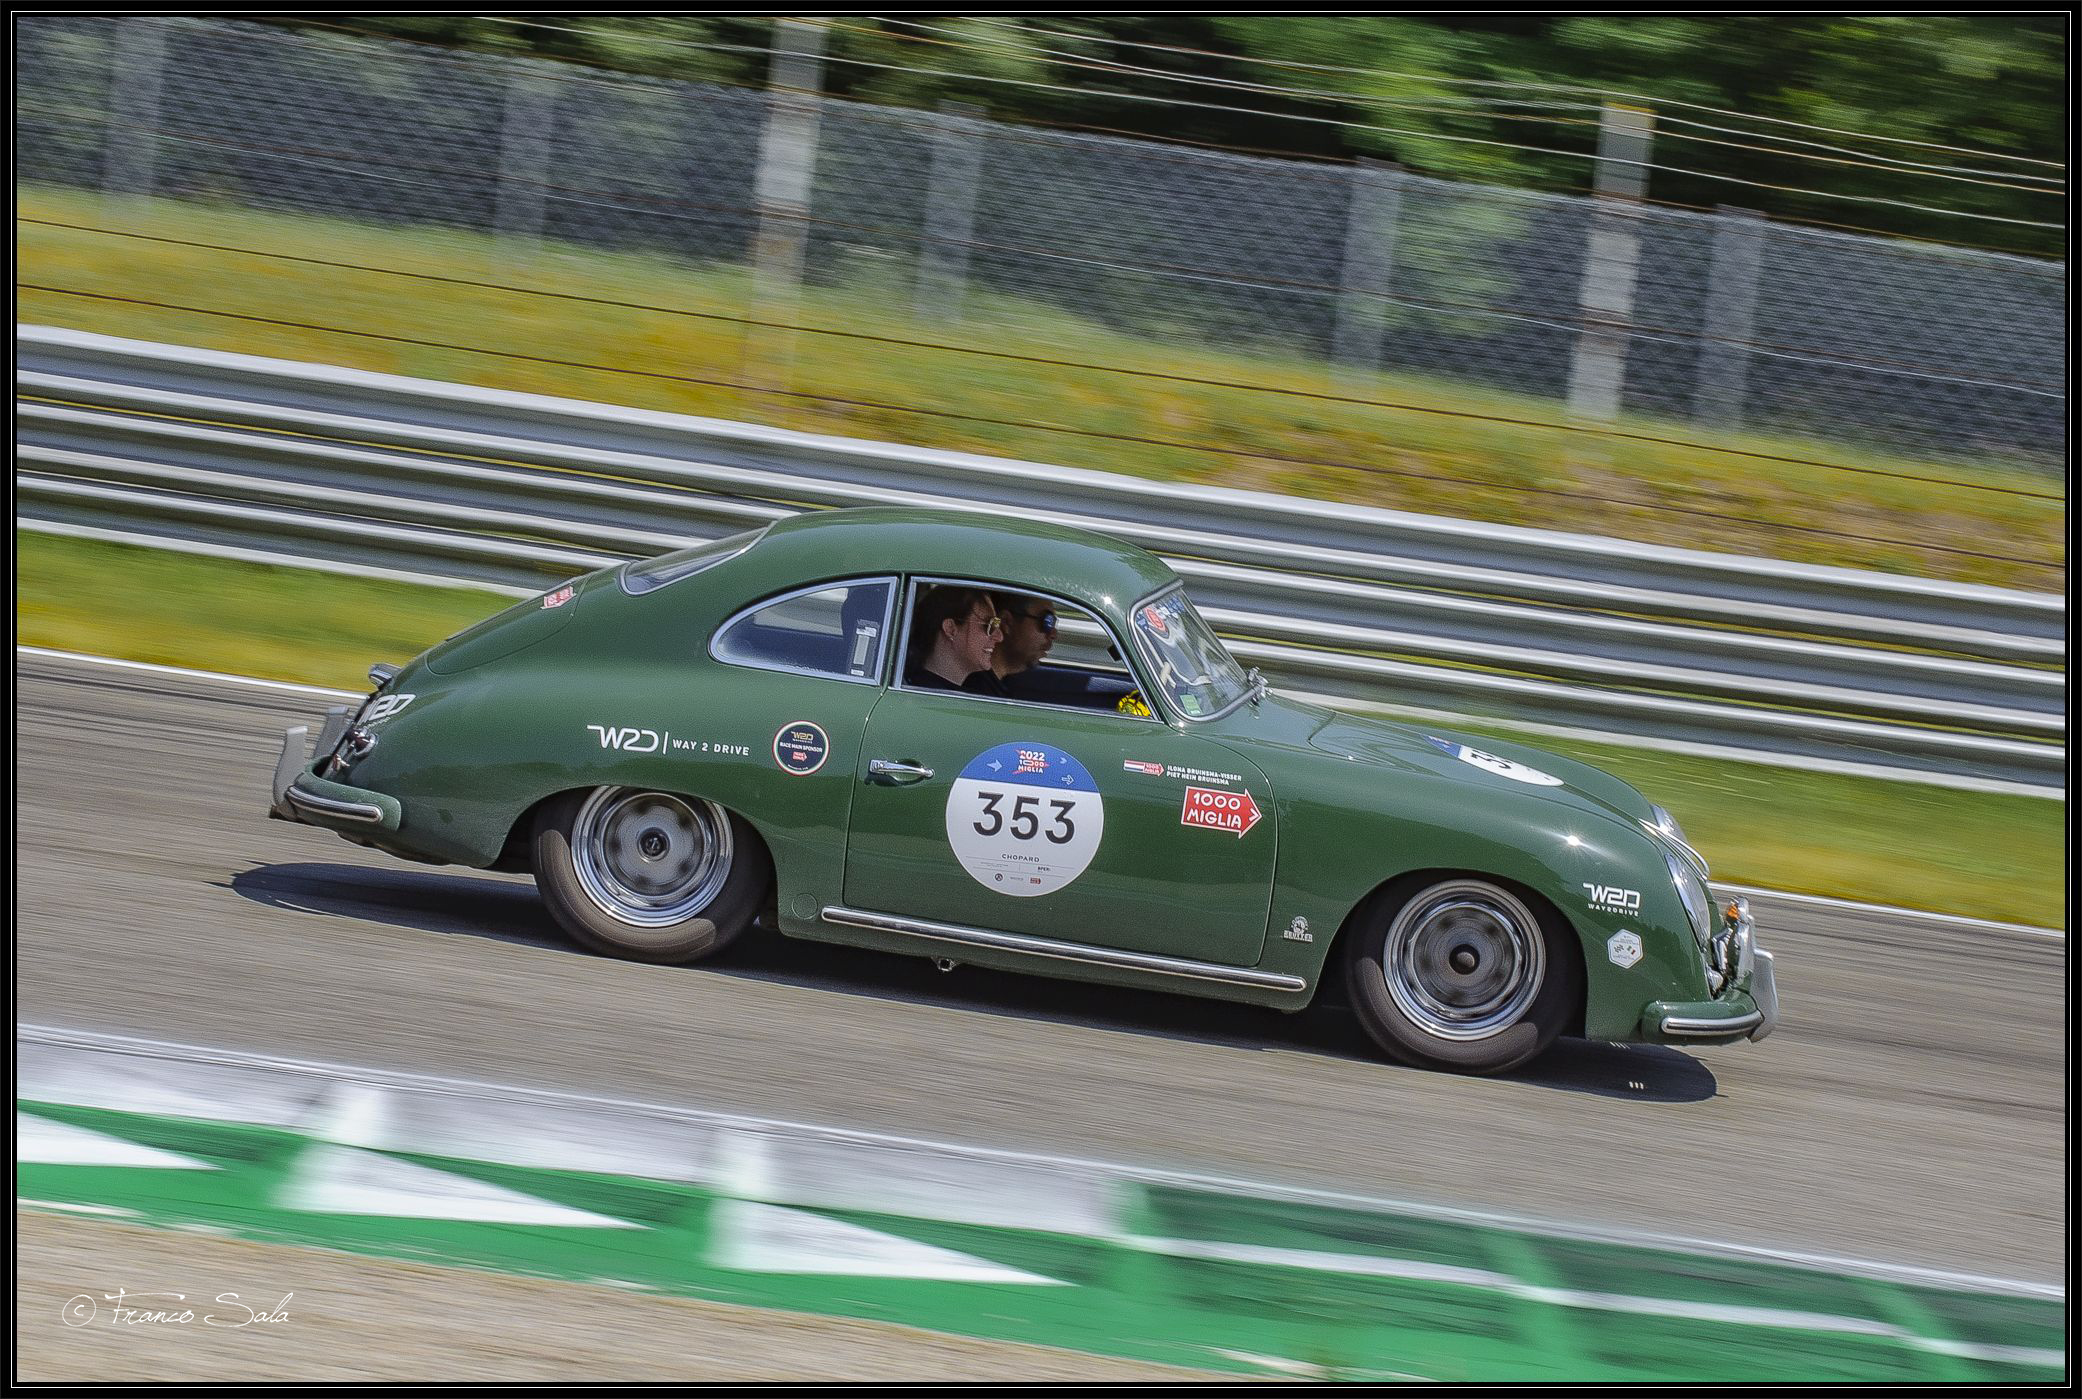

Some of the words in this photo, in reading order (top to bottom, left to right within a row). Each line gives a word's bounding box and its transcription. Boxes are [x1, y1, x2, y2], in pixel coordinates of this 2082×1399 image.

[587, 725, 659, 752] W2D
[673, 739, 698, 750] WAY
[702, 742, 709, 752] 2
[713, 744, 750, 756] DRIVE
[803, 745, 823, 753] SPONSOR
[1020, 750, 1045, 761] 2022
[1018, 765, 1043, 773] MIGLIA
[1167, 765, 1185, 773] ILONA
[1186, 767, 1242, 781] BRUINSMA-VISSER
[1166, 771, 1180, 779] PIET
[1181, 773, 1197, 781] HEIN
[1198, 775, 1230, 785] BRUINSMA
[1193, 791, 1241, 811] 1000
[973, 791, 1076, 844] 353
[1186, 808, 1242, 829] MIGLIA
[1001, 853, 1040, 863] CHOPARD
[1582, 882, 1641, 909] W2D
